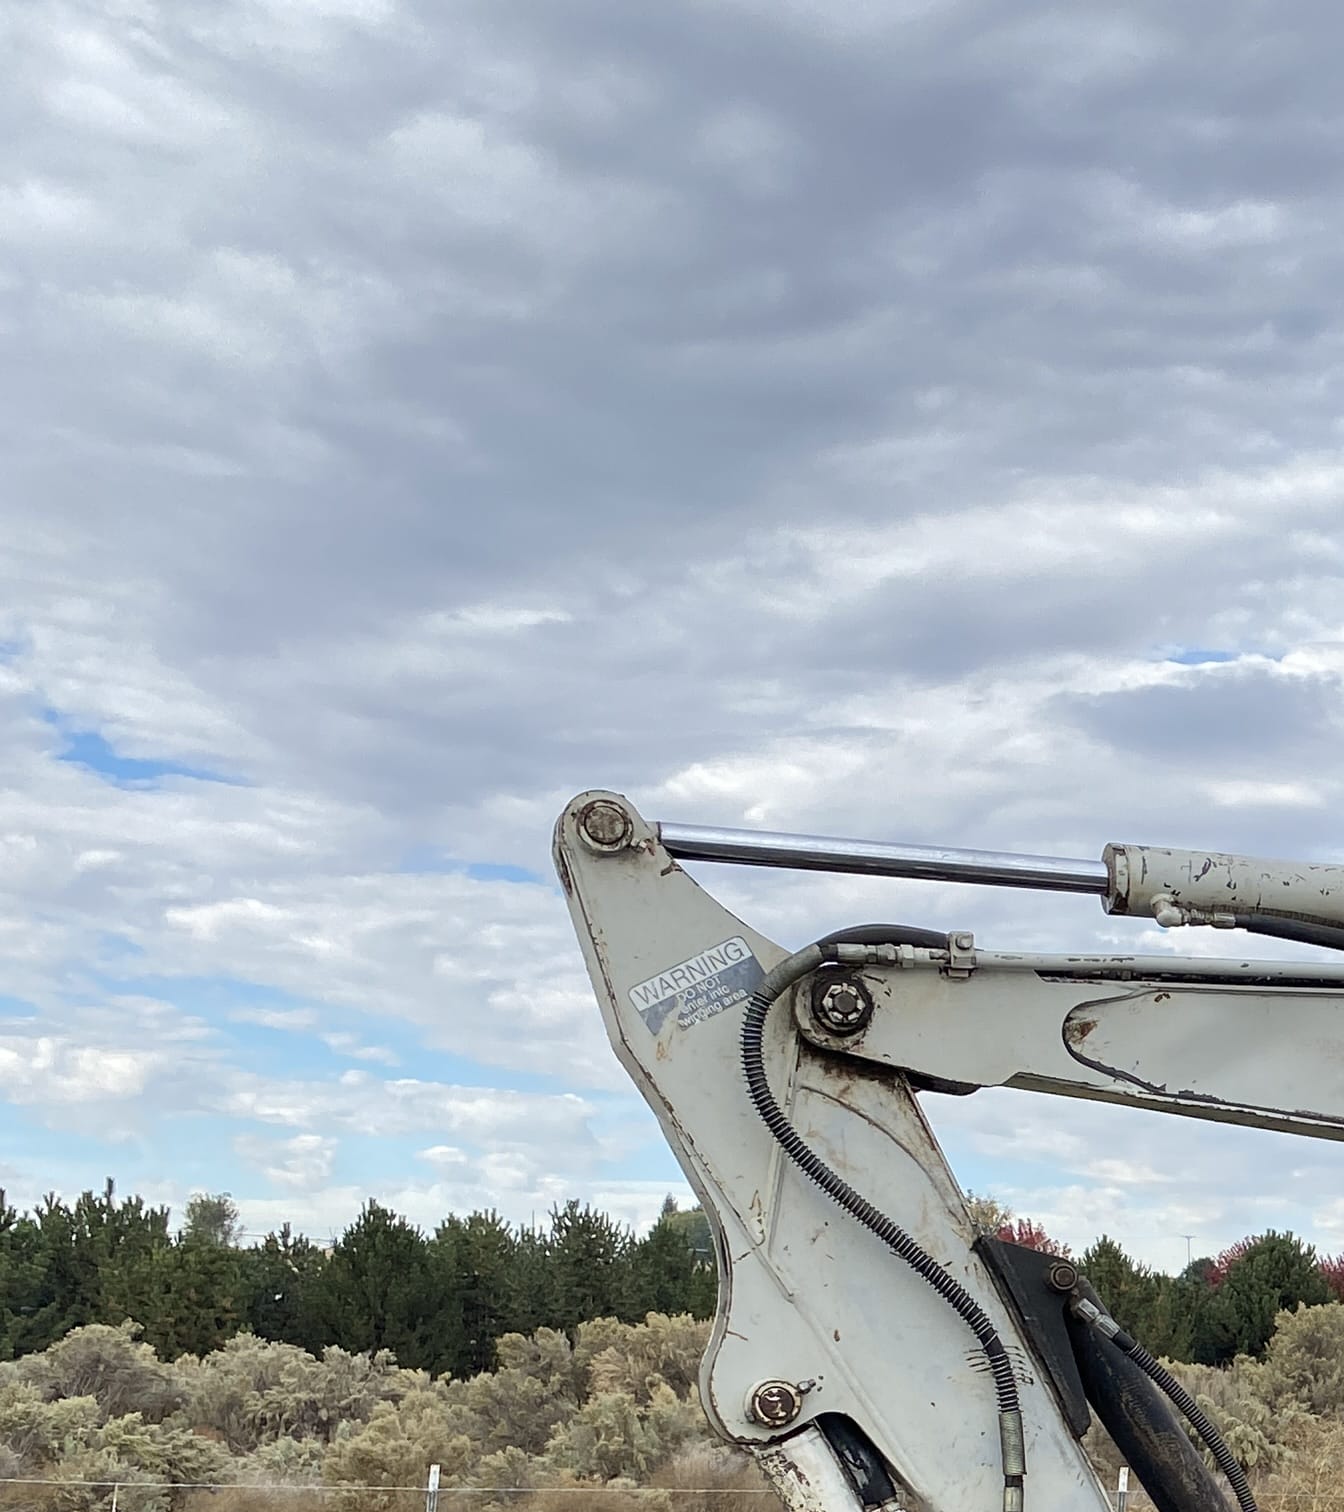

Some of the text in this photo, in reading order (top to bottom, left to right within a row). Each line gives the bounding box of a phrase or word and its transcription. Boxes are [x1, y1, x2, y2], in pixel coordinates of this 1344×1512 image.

[634, 942, 745, 1005] WARNING
[676, 975, 721, 1003] DO NOT
[677, 988, 748, 1028] winging area
[681, 995, 709, 1014] enter
